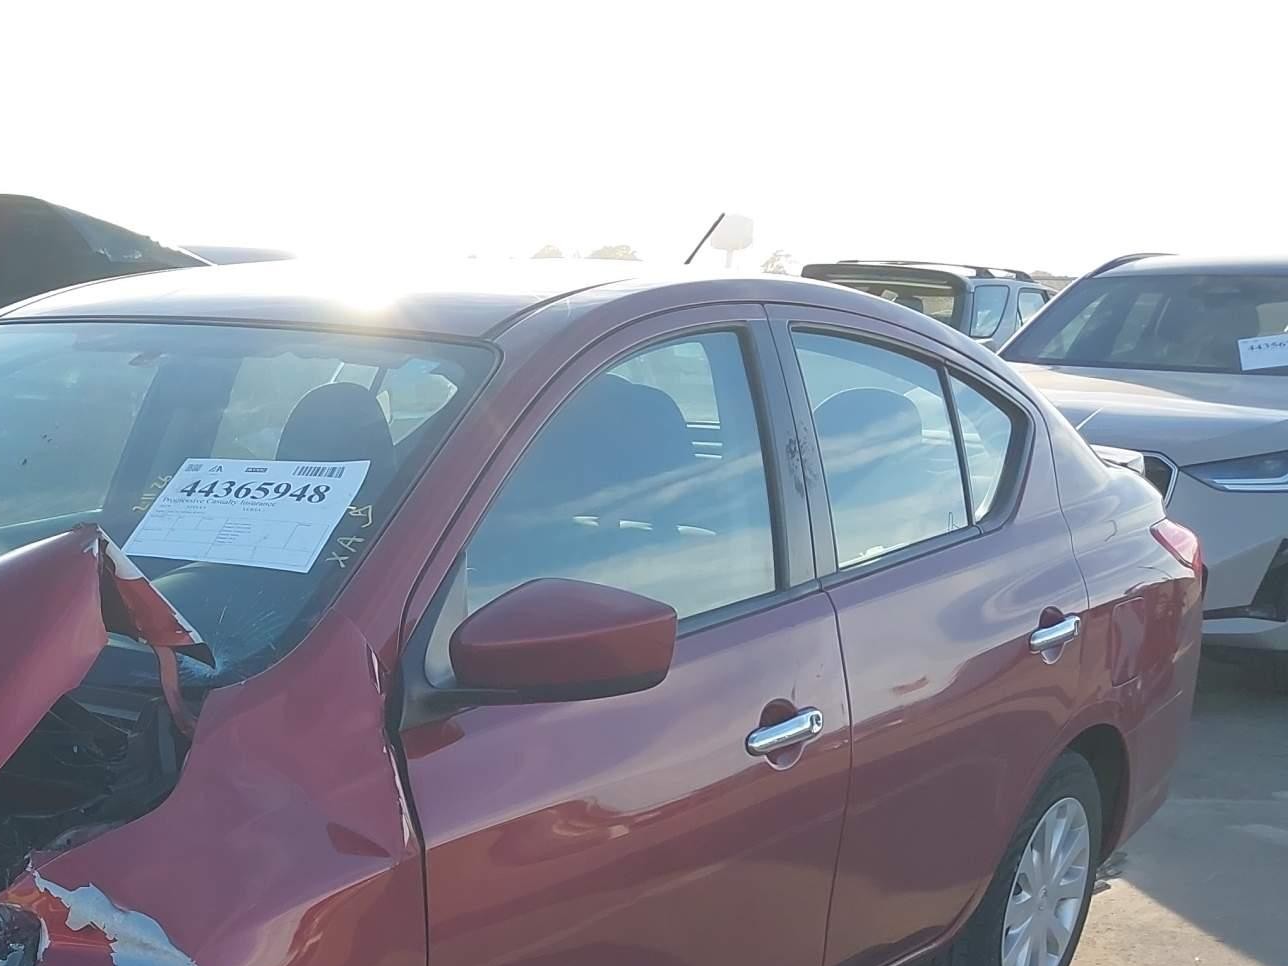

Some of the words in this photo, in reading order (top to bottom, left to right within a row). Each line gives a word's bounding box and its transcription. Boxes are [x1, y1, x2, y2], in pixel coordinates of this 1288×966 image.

[180, 479, 331, 504] 44365948
[206, 498, 237, 506] Casualty
[240, 499, 277, 508] Insurance
